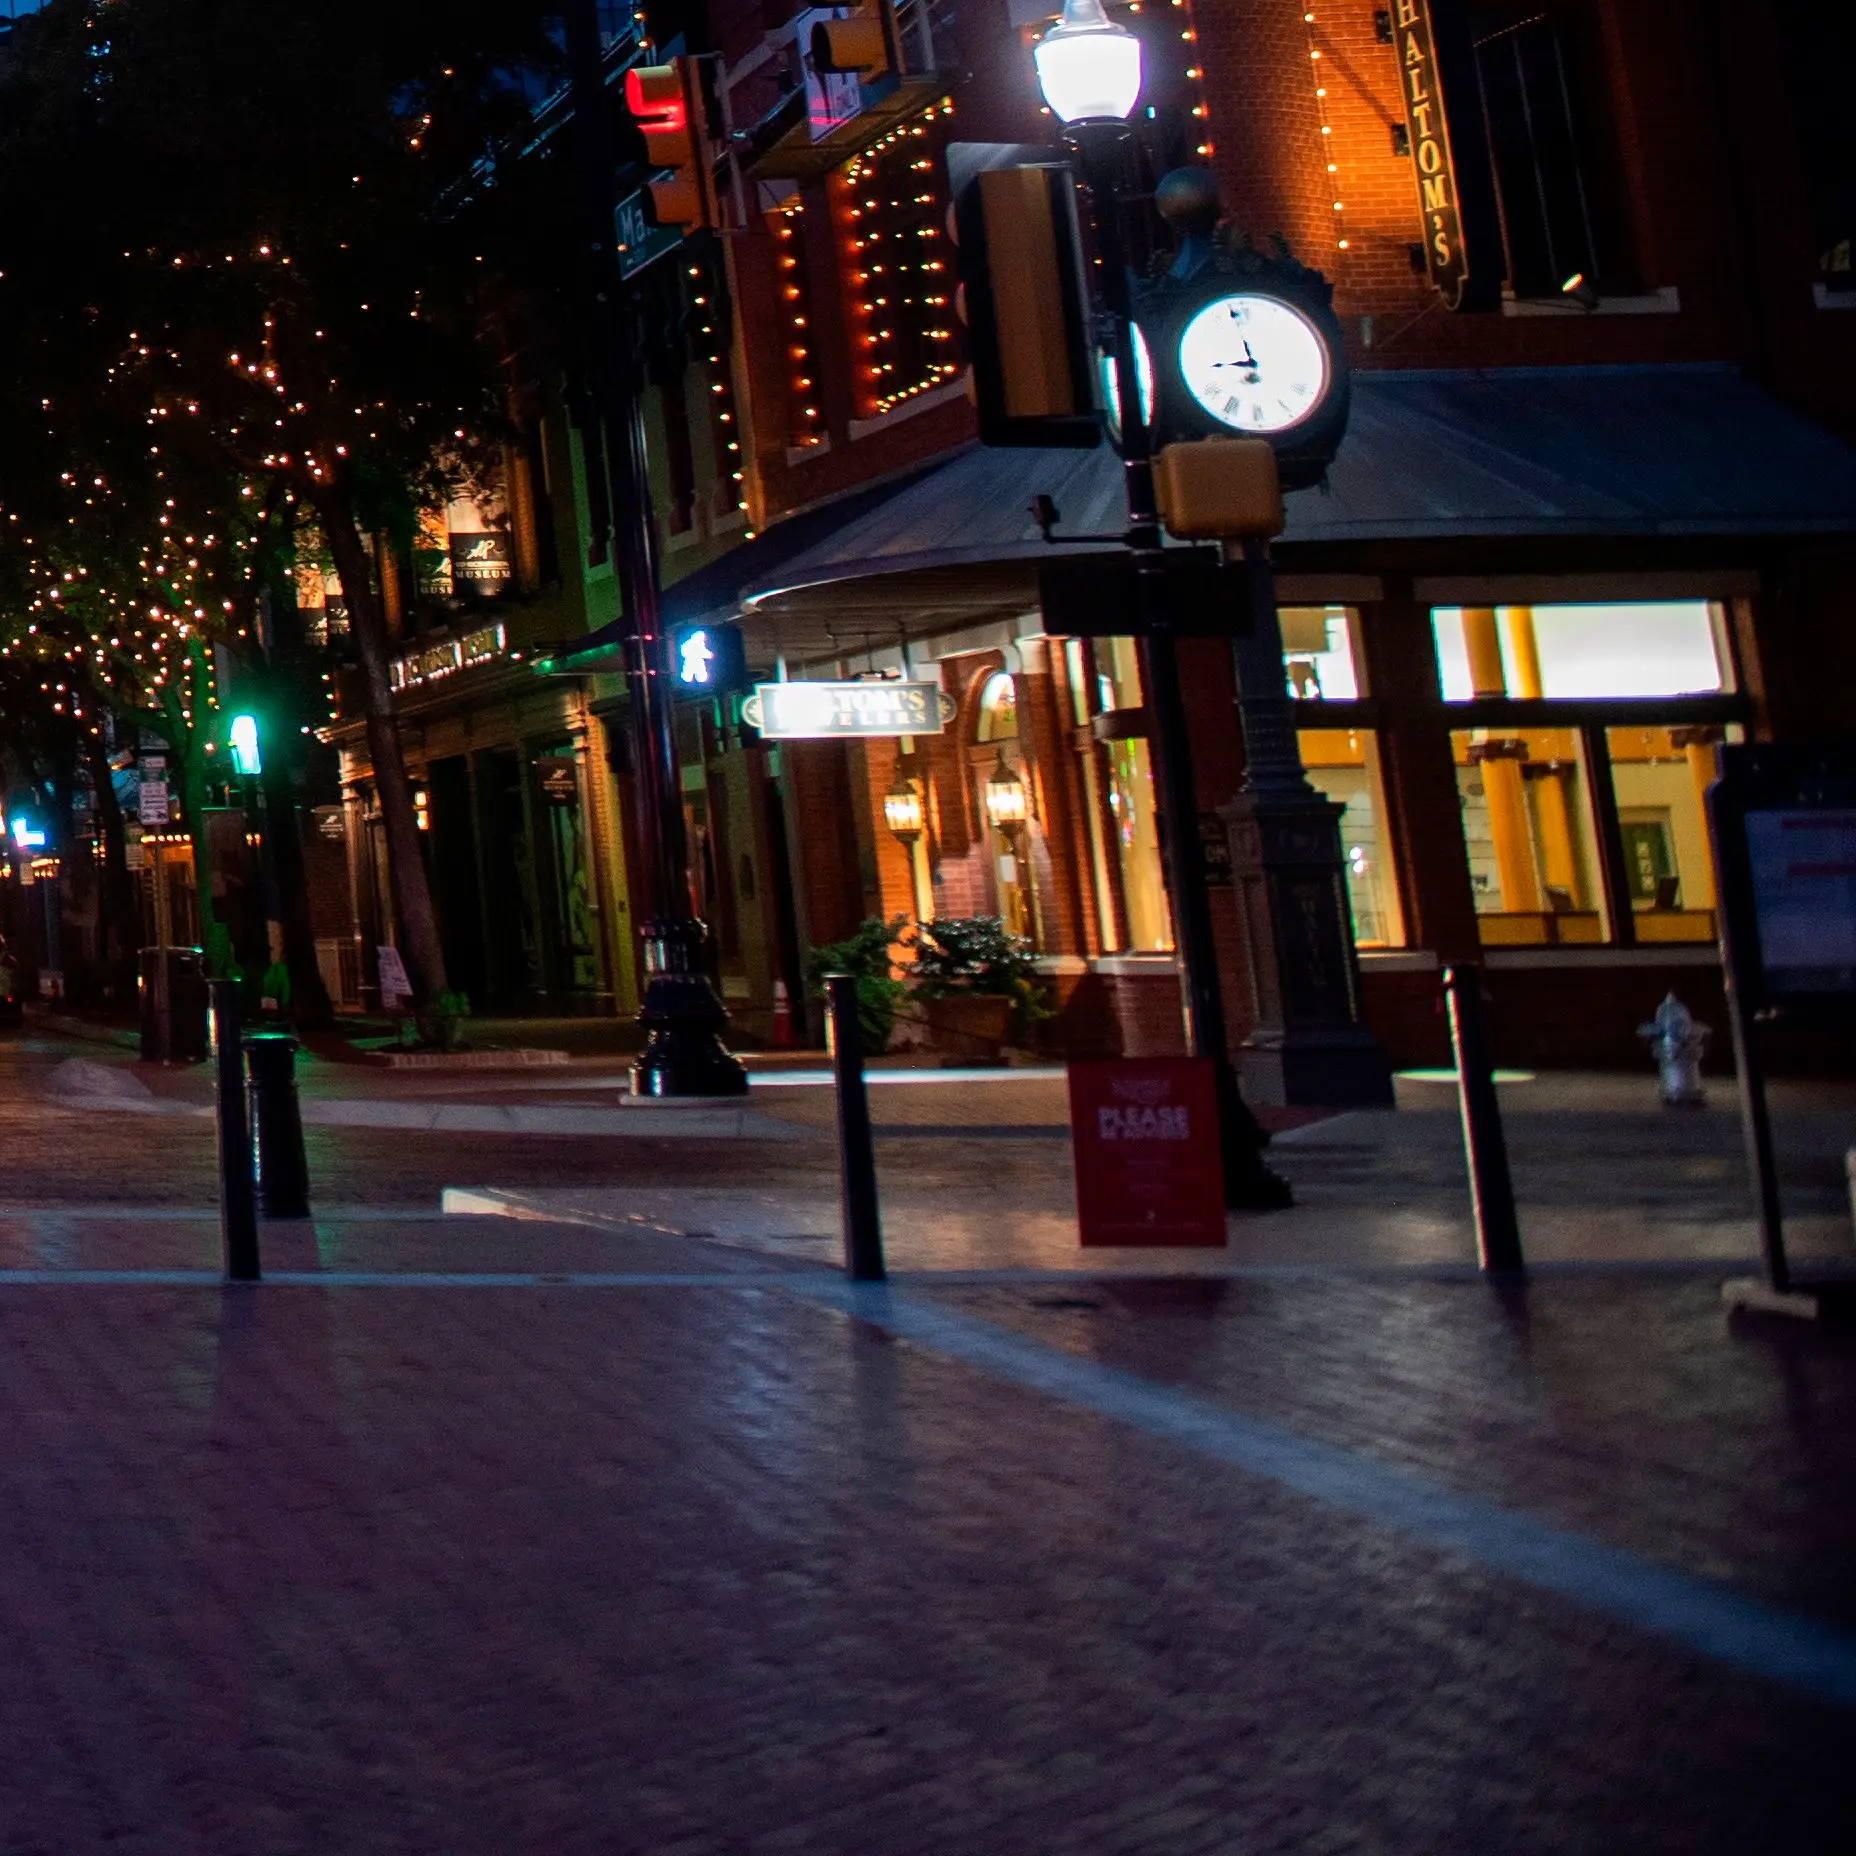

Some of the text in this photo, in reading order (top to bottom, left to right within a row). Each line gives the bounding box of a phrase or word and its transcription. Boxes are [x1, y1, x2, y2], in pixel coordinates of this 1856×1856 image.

[454, 569, 511, 579] MUSEUM
[419, 585, 454, 595] MUSE
[1098, 1105, 1190, 1126] PLEASE
